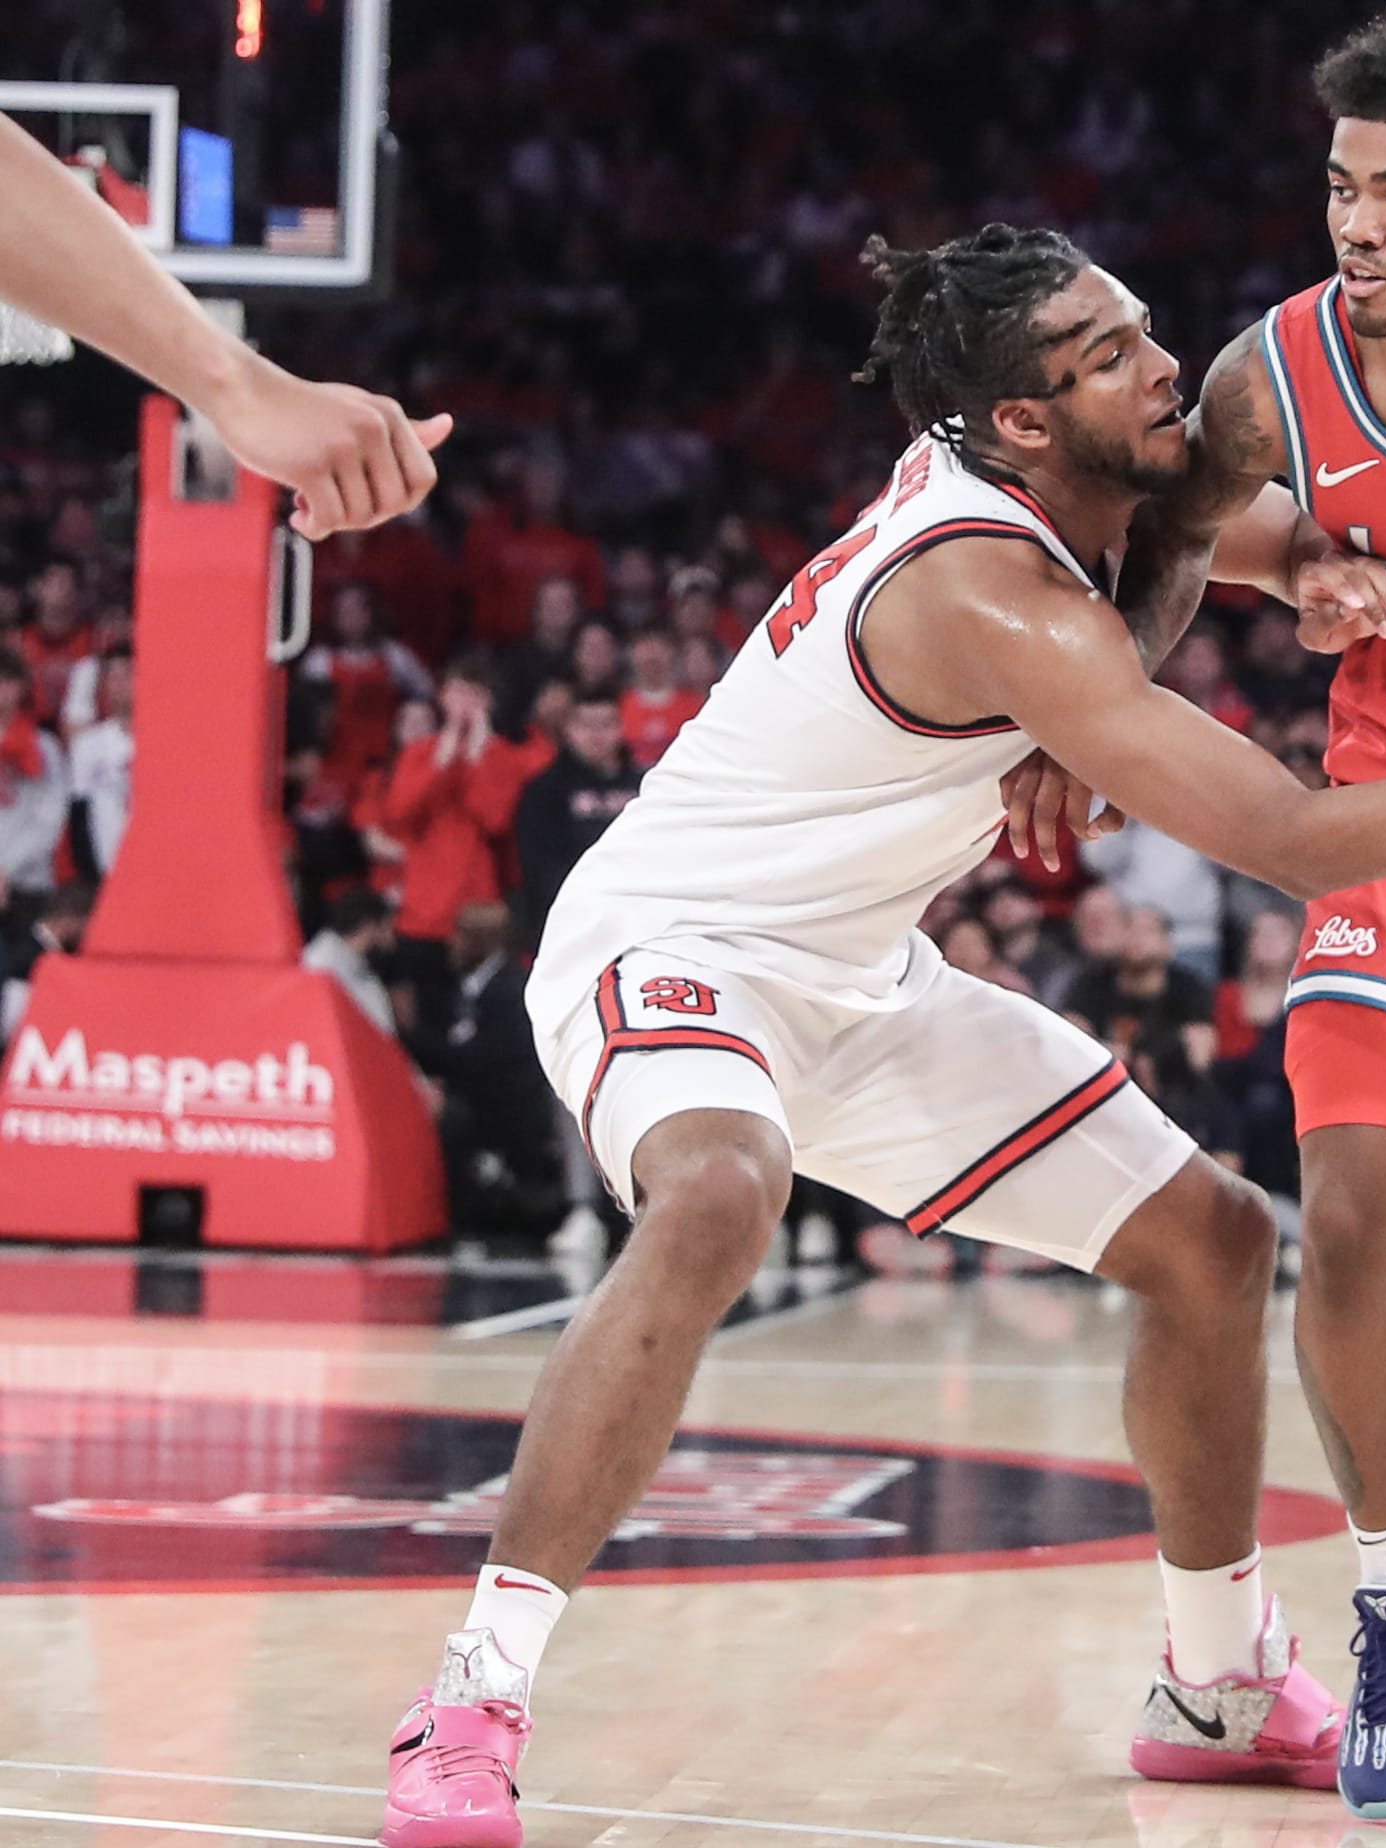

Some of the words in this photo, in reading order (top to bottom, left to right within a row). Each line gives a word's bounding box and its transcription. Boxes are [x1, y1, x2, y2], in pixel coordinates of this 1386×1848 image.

[1305, 914, 1378, 961] Lobos
[8, 1025, 334, 1117] Maspeth
[1, 1109, 166, 1152] FEDERAL
[171, 1120, 335, 1162] SAVINGS
